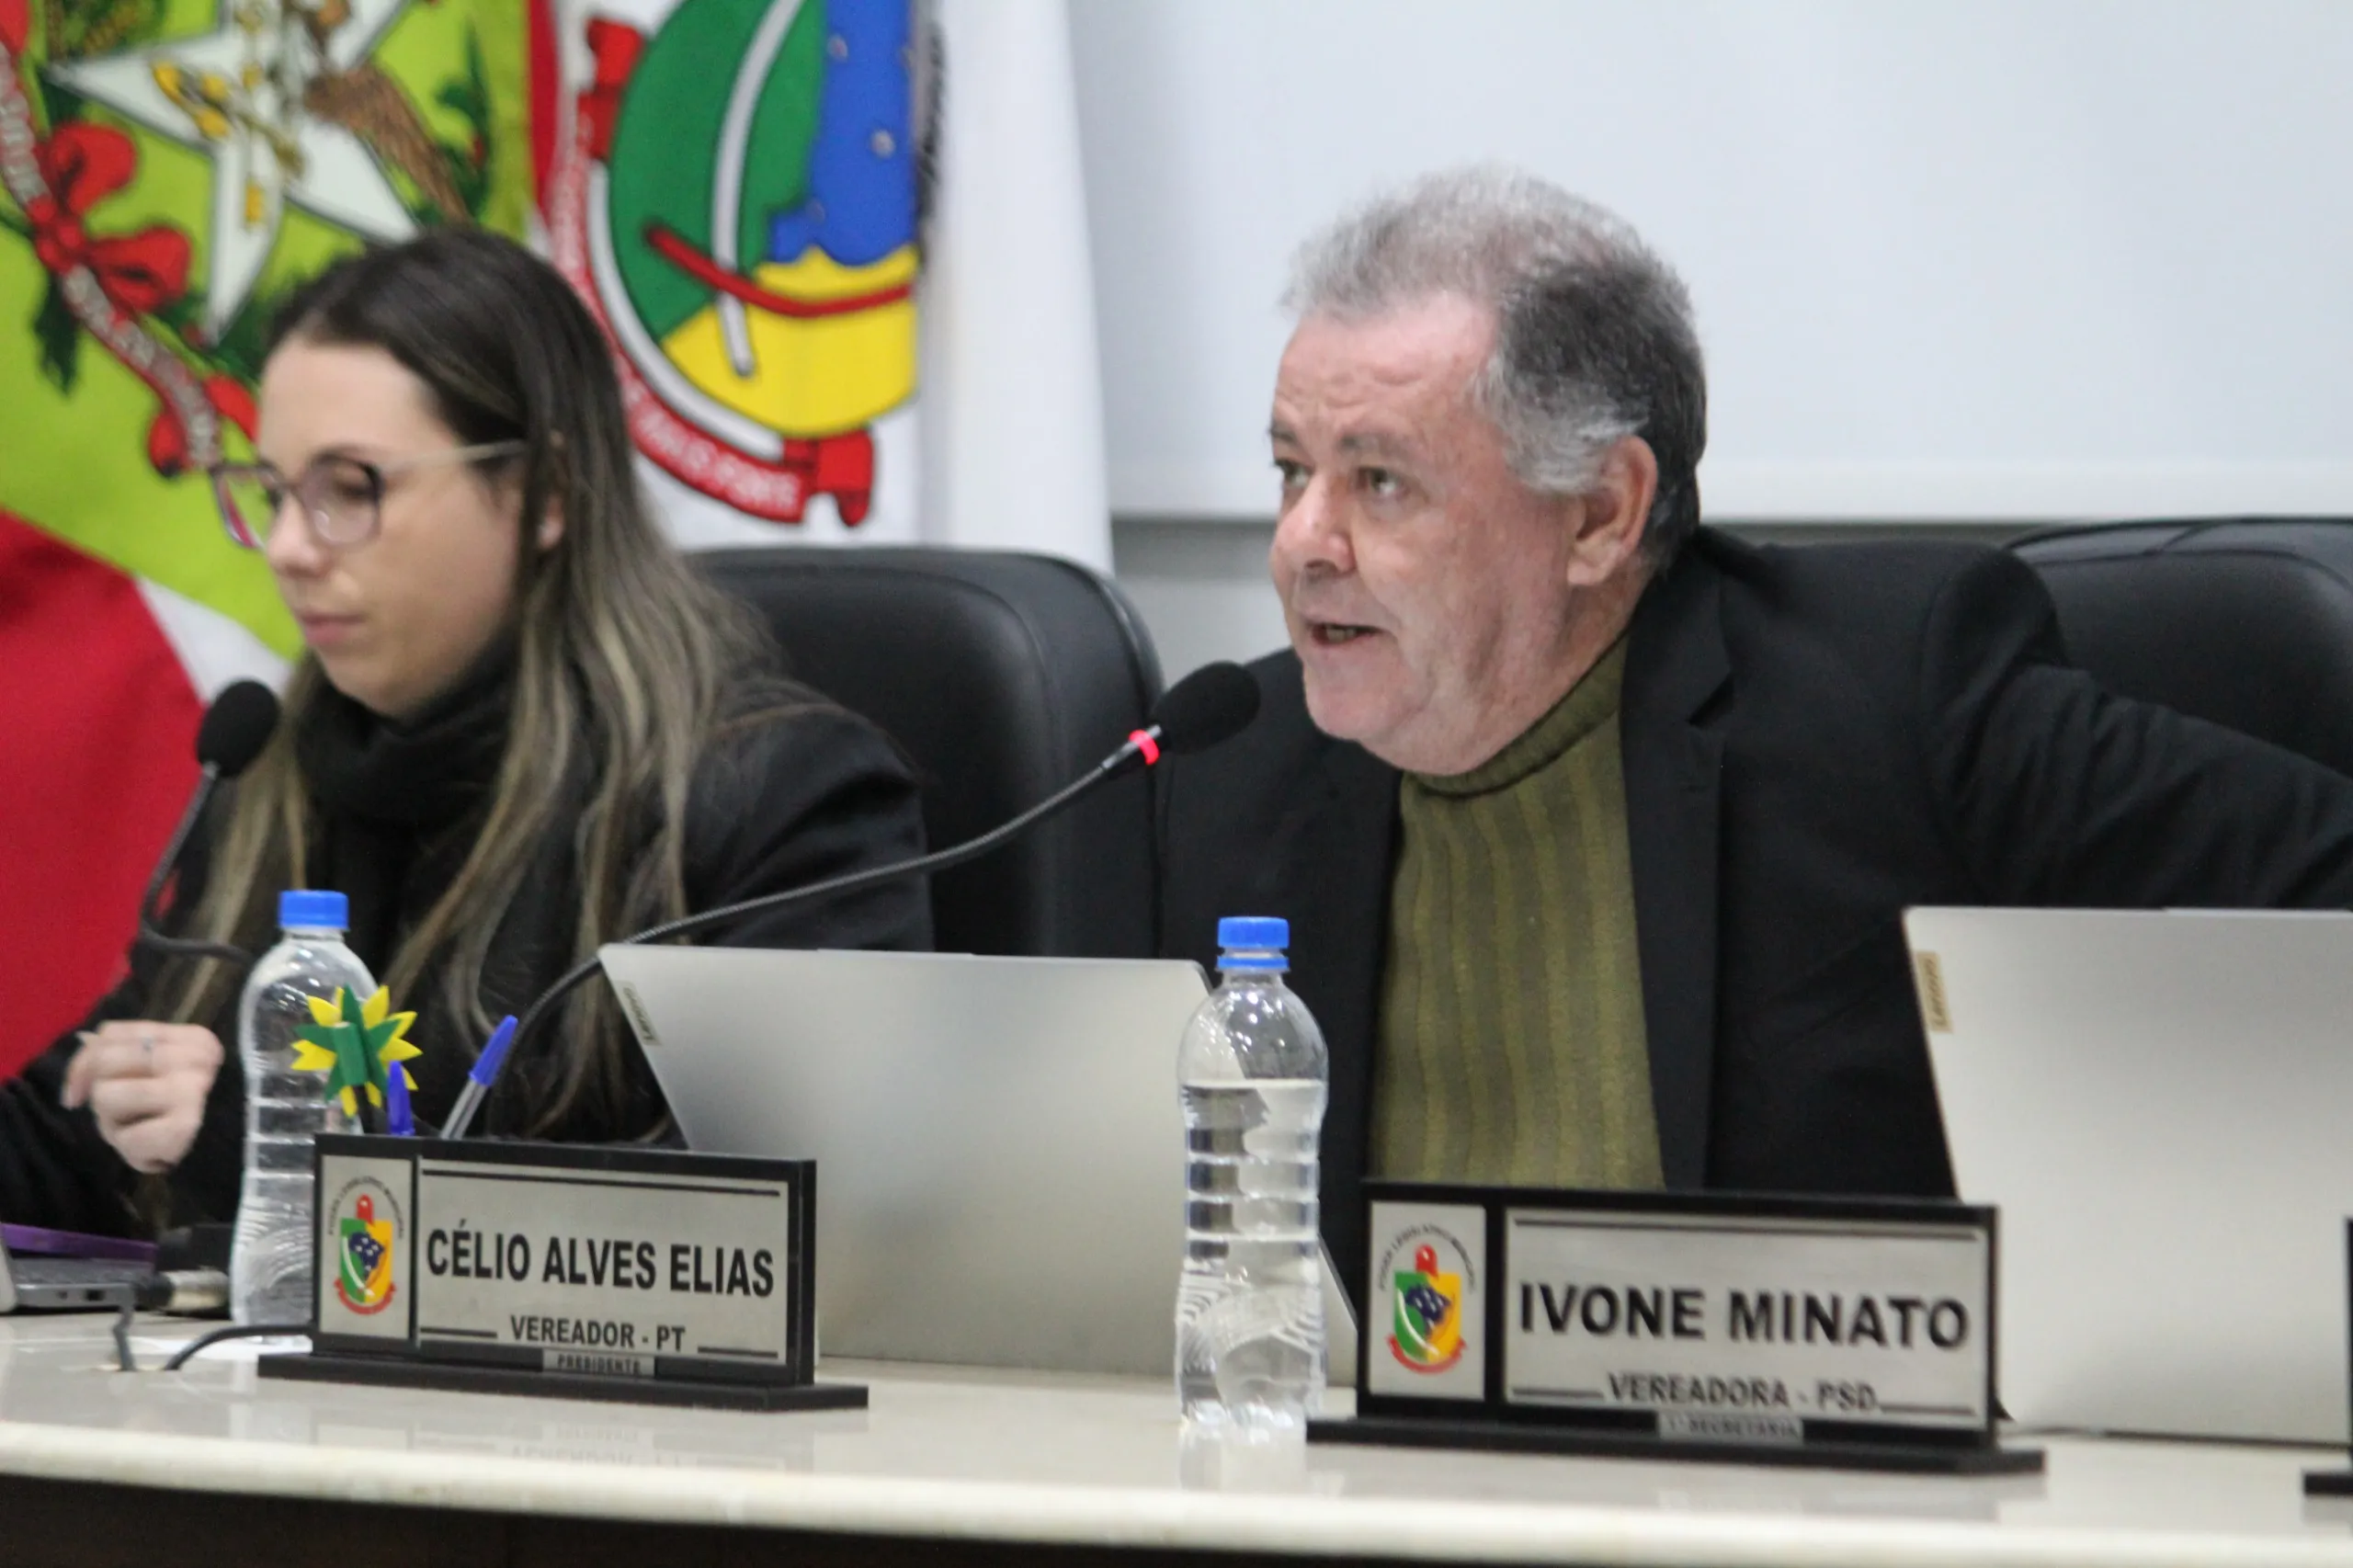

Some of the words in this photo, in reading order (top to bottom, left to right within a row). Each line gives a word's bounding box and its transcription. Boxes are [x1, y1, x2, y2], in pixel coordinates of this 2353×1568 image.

[426, 1220, 530, 1282] CÉLIO
[542, 1236, 656, 1290] ALVES
[670, 1244, 774, 1298] ELIAS
[510, 1315, 634, 1348] VEREADOR
[657, 1324, 686, 1352] PT
[1519, 1282, 1705, 1340] IVONE
[1729, 1290, 1970, 1351] MINATO
[1608, 1373, 1788, 1409] VEREADORA
[1817, 1382, 1877, 1414] PSD
